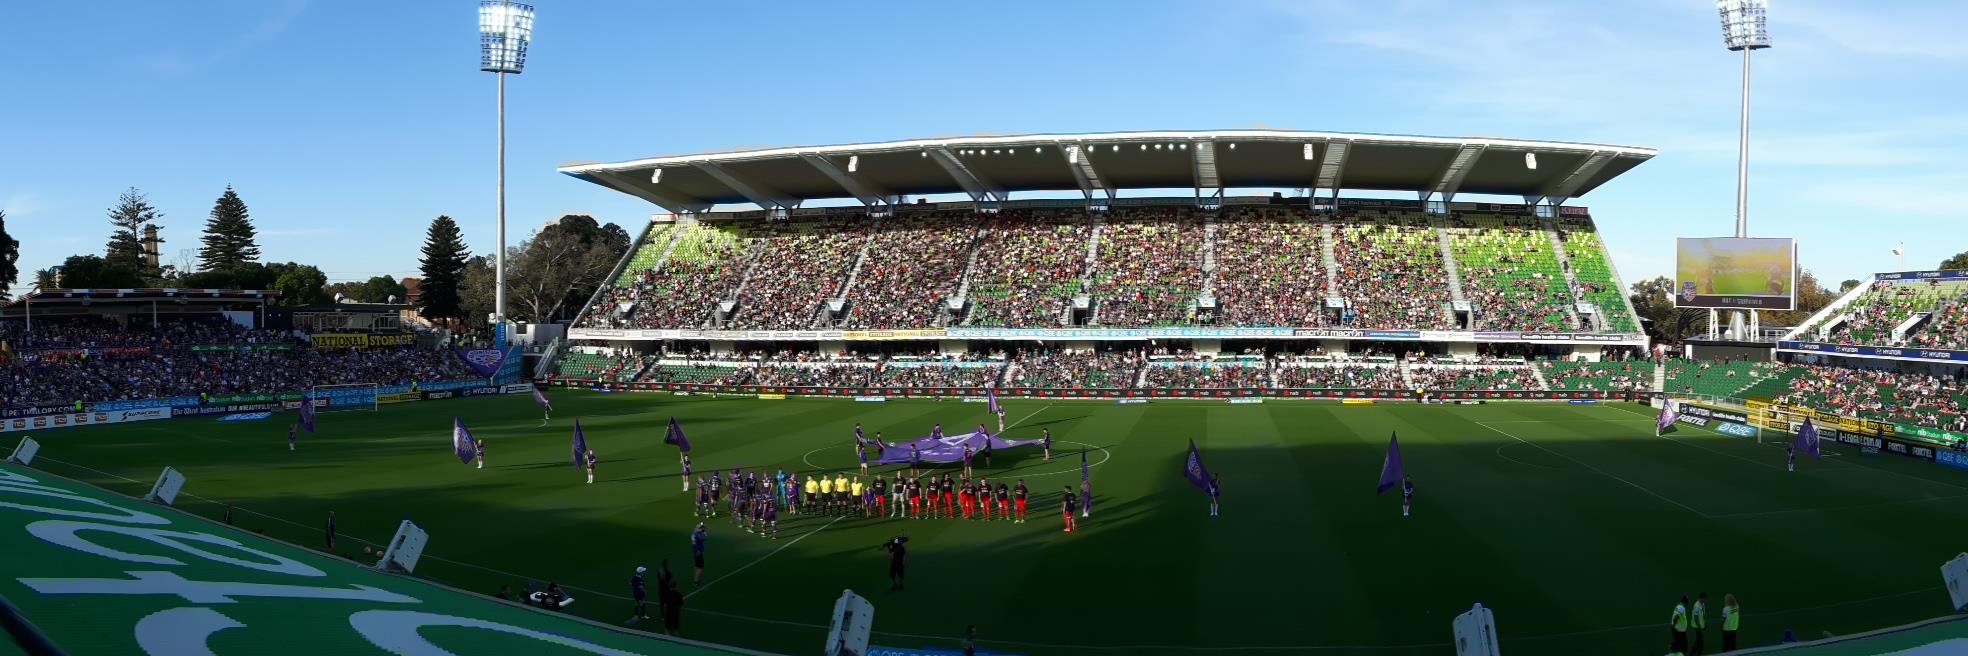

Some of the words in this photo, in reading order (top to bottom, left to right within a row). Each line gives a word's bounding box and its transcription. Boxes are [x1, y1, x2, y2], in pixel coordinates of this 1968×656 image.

[1295, 329, 1329, 337] macron
[1330, 329, 1364, 337] macron
[312, 336, 365, 348] NATIONAL
[369, 334, 413, 346] STORAGE
[473, 387, 497, 395] HYUNDAI
[1678, 414, 1707, 427] FOXTEL
[1867, 421, 1894, 432] STOAGE
[1729, 424, 1752, 436] QBE
[1888, 442, 1907, 454] FOXTEL
[1912, 447, 1933, 458] FOXTEL
